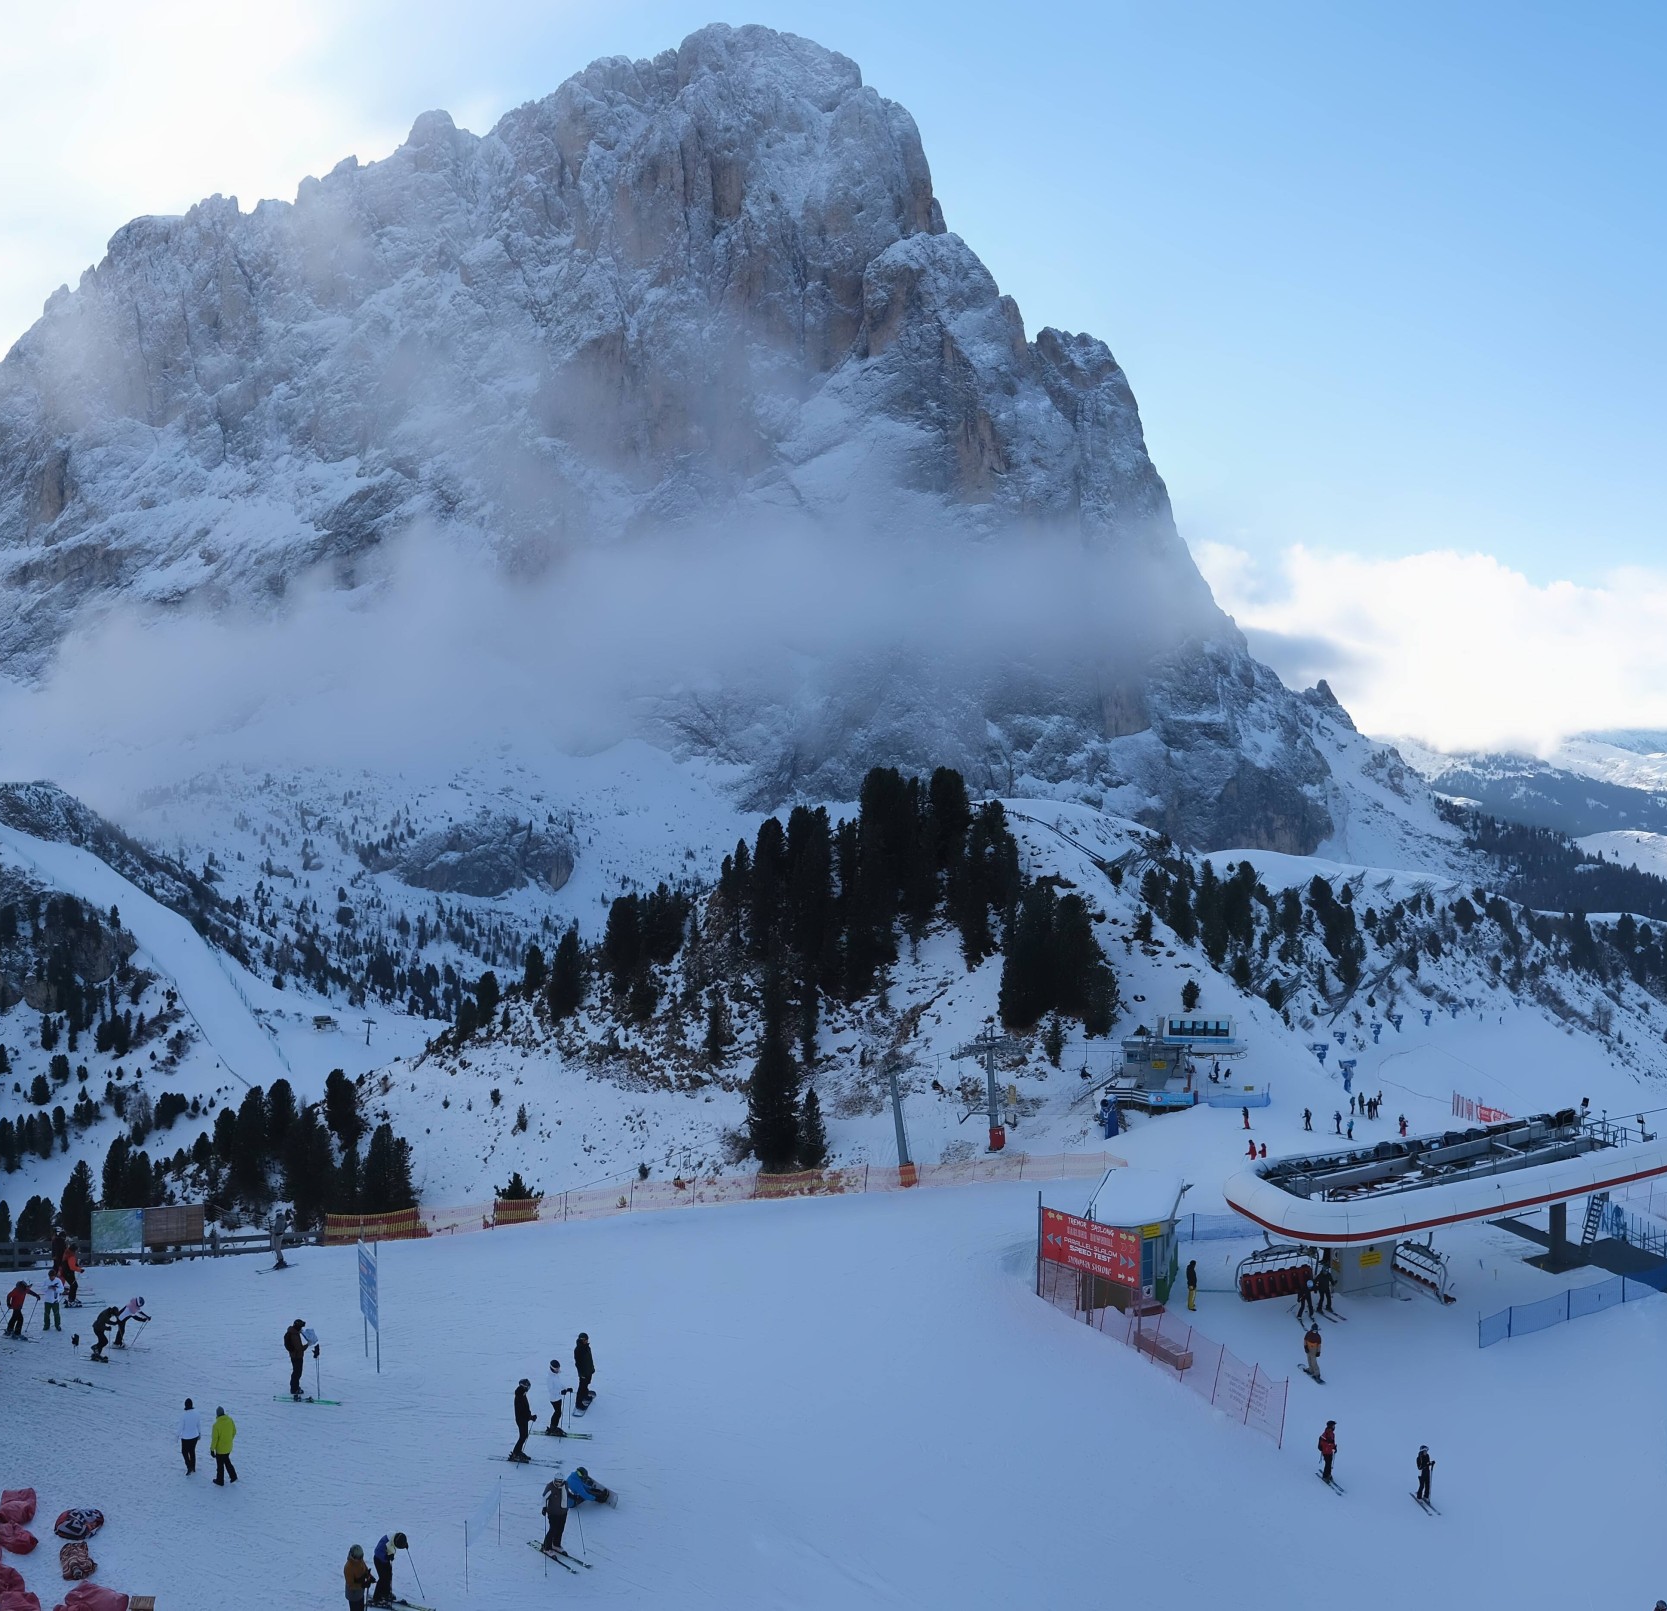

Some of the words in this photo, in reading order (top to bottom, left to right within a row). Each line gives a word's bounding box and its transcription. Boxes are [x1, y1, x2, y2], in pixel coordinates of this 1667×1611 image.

[1064, 1237, 1093, 1250] PARALLEL
[1094, 1246, 1117, 1258] SLALOM
[1069, 1245, 1092, 1257] SPEED
[1093, 1252, 1111, 1262] TEST
